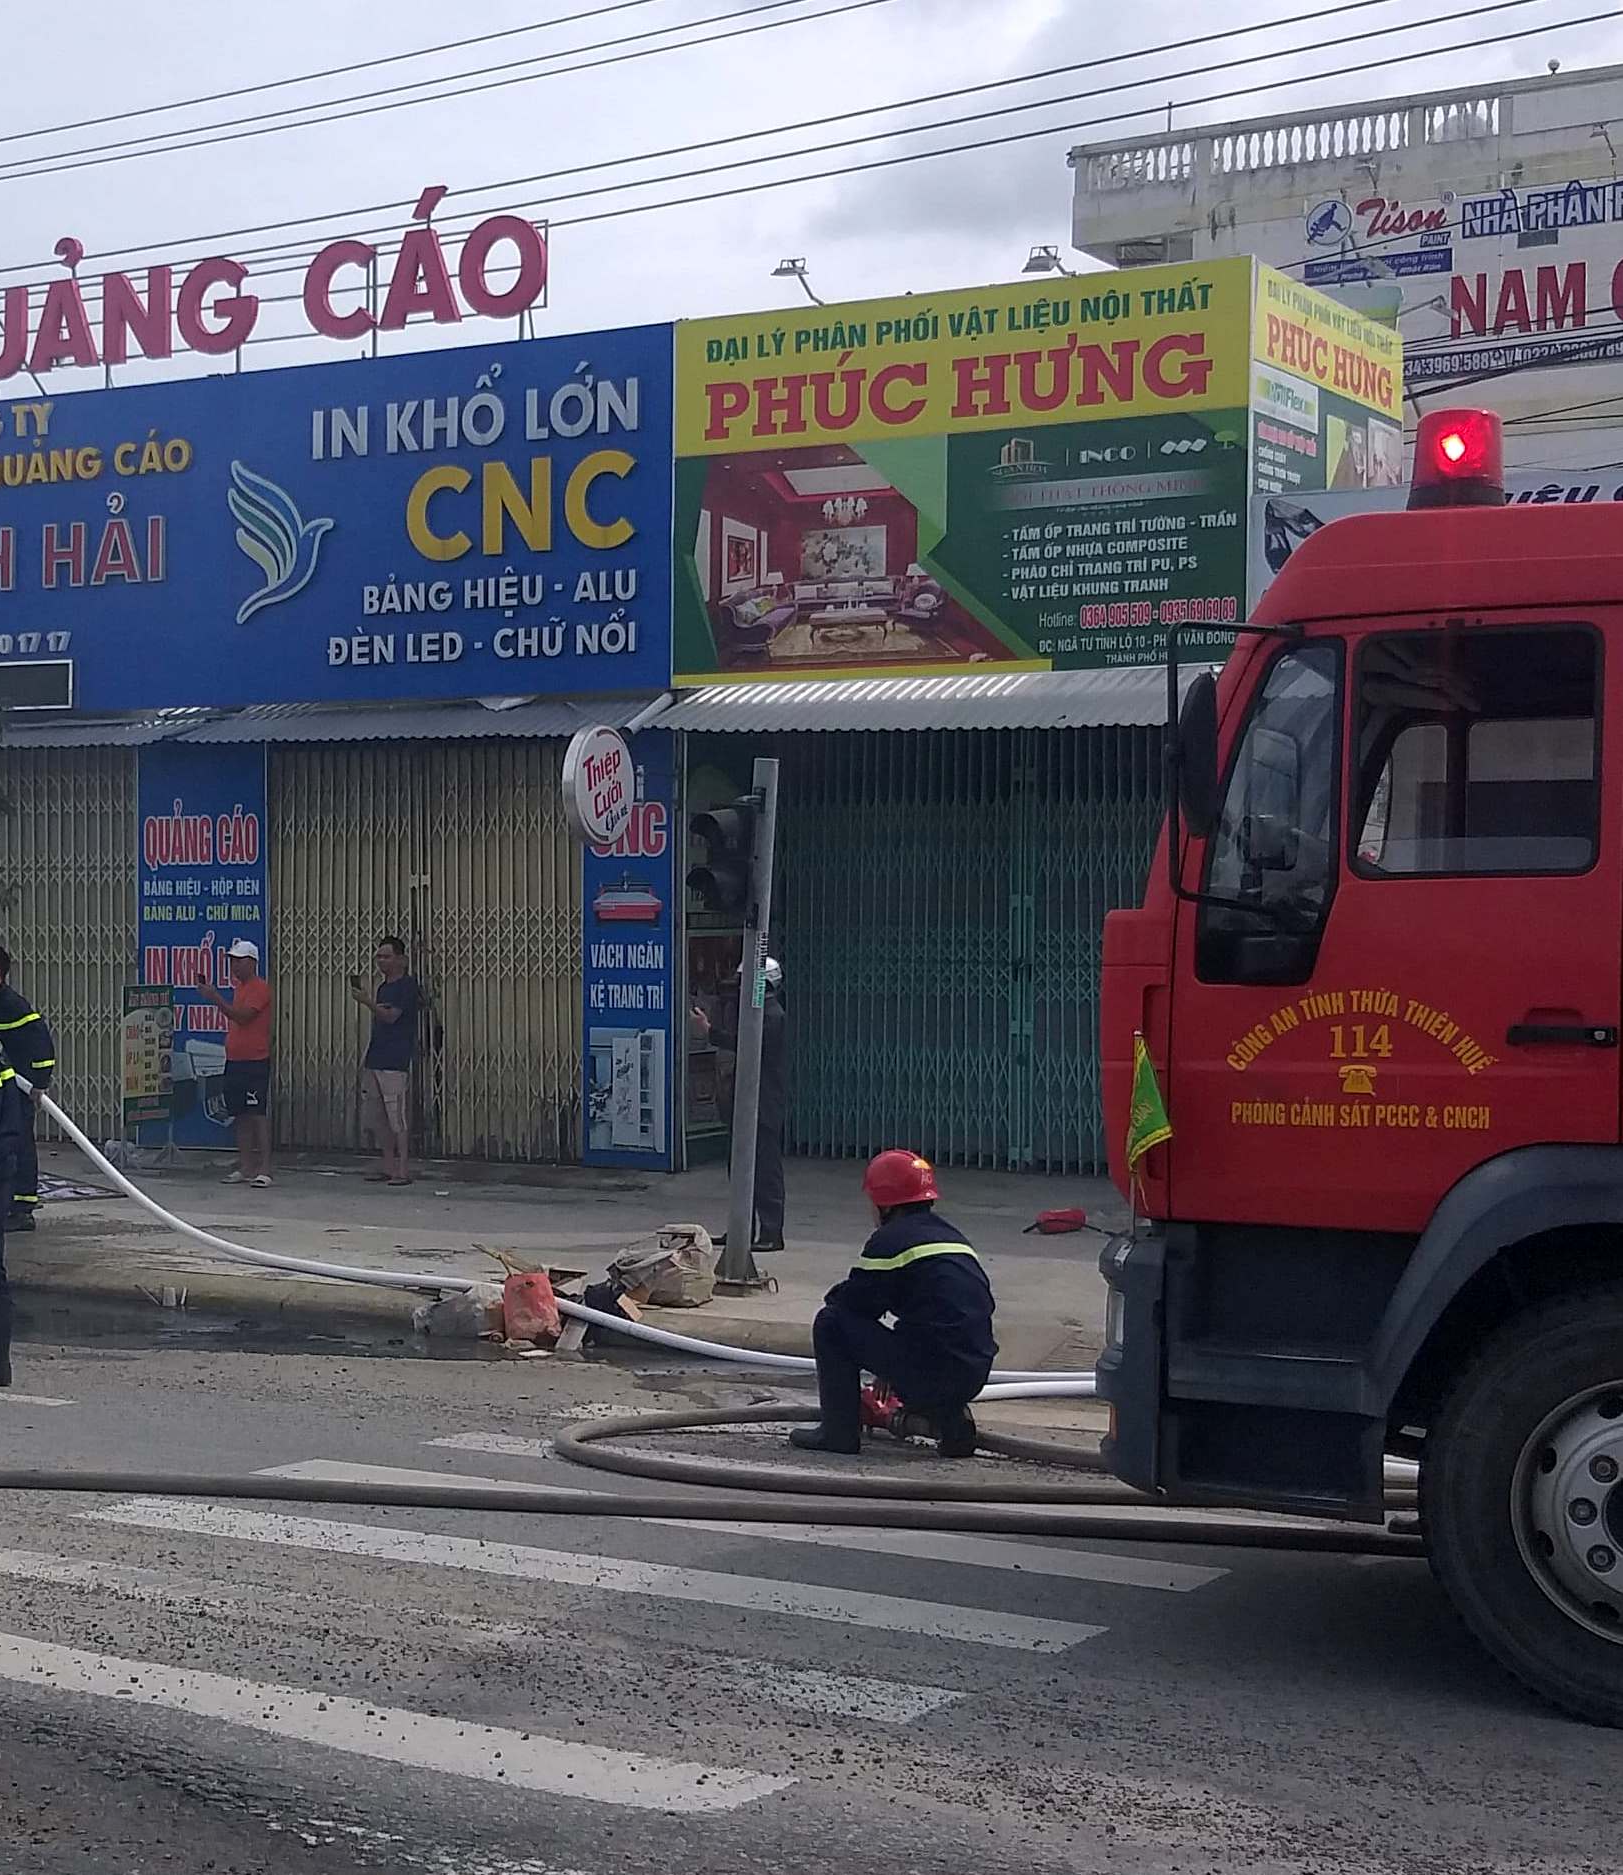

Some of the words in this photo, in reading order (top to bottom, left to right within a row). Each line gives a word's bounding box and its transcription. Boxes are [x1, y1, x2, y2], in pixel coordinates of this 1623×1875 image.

[1356, 197, 1448, 238] Tison
[1461, 188, 1523, 239] NHÀ
[1526, 179, 1606, 232] PHÂN
[1420, 232, 1451, 248] PAINT
[303, 185, 548, 340] CÁO
[706, 336, 749, 367] ĐẠI
[756, 326, 786, 358] LÝ
[794, 321, 867, 354] PHÂN
[876, 308, 939, 345] PHỐI
[948, 305, 999, 342] VẬT
[1007, 295, 1071, 332] LIỆU
[1080, 288, 1130, 327] NỘI
[1139, 276, 1214, 316] THẤT
[1450, 262, 1586, 340] NAM
[1266, 311, 1328, 380] PHÚC
[1333, 343, 1394, 409] HƯNG
[704, 351, 928, 441] PHÚC
[951, 332, 1214, 419] HƯNG
[12, 401, 55, 438] TY
[312, 405, 368, 461] IN
[386, 362, 505, 454] KHỔ
[526, 360, 639, 441] LỚN
[113, 428, 193, 476] CÁO
[1079, 446, 1137, 465] INCO
[406, 449, 637, 561] CNC
[42, 491, 166, 590] HẢI
[1011, 542, 1041, 562] TẤM
[1043, 542, 1063, 560] ỐP
[1066, 539, 1104, 562] NHỰA
[1107, 535, 1189, 556] COMPOSITE
[1012, 523, 1042, 542] TẤM
[1044, 522, 1063, 540] ỐP
[1067, 521, 1111, 539] TRANG
[1114, 517, 1136, 536] TRÍ
[1139, 515, 1186, 534] TƯỜNG
[1077, 558, 1122, 578] TRANG
[1125, 555, 1147, 574] TRÍ
[1178, 555, 1198, 571] PS
[363, 573, 453, 616] BẢNG
[463, 566, 544, 618] HIỆU
[572, 568, 637, 602] ALU
[1011, 583, 1037, 602] VẬT
[1039, 581, 1069, 601] LIỆU
[1072, 580, 1120, 598] KHUNG
[1122, 576, 1170, 595] TRANH
[1108, 602, 1129, 628] 905
[1129, 601, 1152, 626] 509
[17, 632, 42, 655] 17
[46, 630, 73, 653] 17
[328, 626, 395, 667] ĐÈN
[406, 631, 464, 664] LED
[492, 616, 569, 660] CHỮ
[575, 608, 637, 655] NỔI
[582, 748, 622, 792] Thiệp
[593, 779, 623, 820] Cưới
[143, 798, 214, 872] QUẢNG
[216, 803, 260, 866] CÁO
[590, 801, 667, 857] NC
[143, 874, 173, 897] BẢNG
[175, 876, 202, 901] HIỆU
[211, 878, 234, 901] HỘP
[235, 877, 260, 897] ĐÈN
[143, 899, 173, 922] BẢNG
[175, 904, 197, 922] ALU
[206, 902, 230, 922] CHỮ
[231, 904, 261, 922] MICA
[144, 944, 168, 986] IN
[171, 929, 215, 989] KHỔ
[590, 939, 625, 969] VÁCH
[627, 939, 665, 969] NGĂN
[590, 978, 605, 1014] KỆ
[607, 983, 644, 1009] TRANG
[646, 979, 665, 1010] TRÍ
[1226, 1022, 1274, 1073] CÔNG
[1269, 1004, 1300, 1036] AN
[1298, 988, 1345, 1022] TỈNH
[1349, 986, 1400, 1018] THỪA
[1403, 999, 1461, 1045] THIÊN
[1451, 1032, 1500, 1076] HUẾ
[1329, 1023, 1394, 1058] 114
[1231, 1098, 1286, 1125] PHÒNG
[1290, 1096, 1335, 1127] CẢNH
[1339, 1099, 1371, 1127] SÁT
[1374, 1103, 1420, 1128] PCCC
[1424, 1105, 1438, 1128] &
[1443, 1105, 1490, 1130] CNCH
